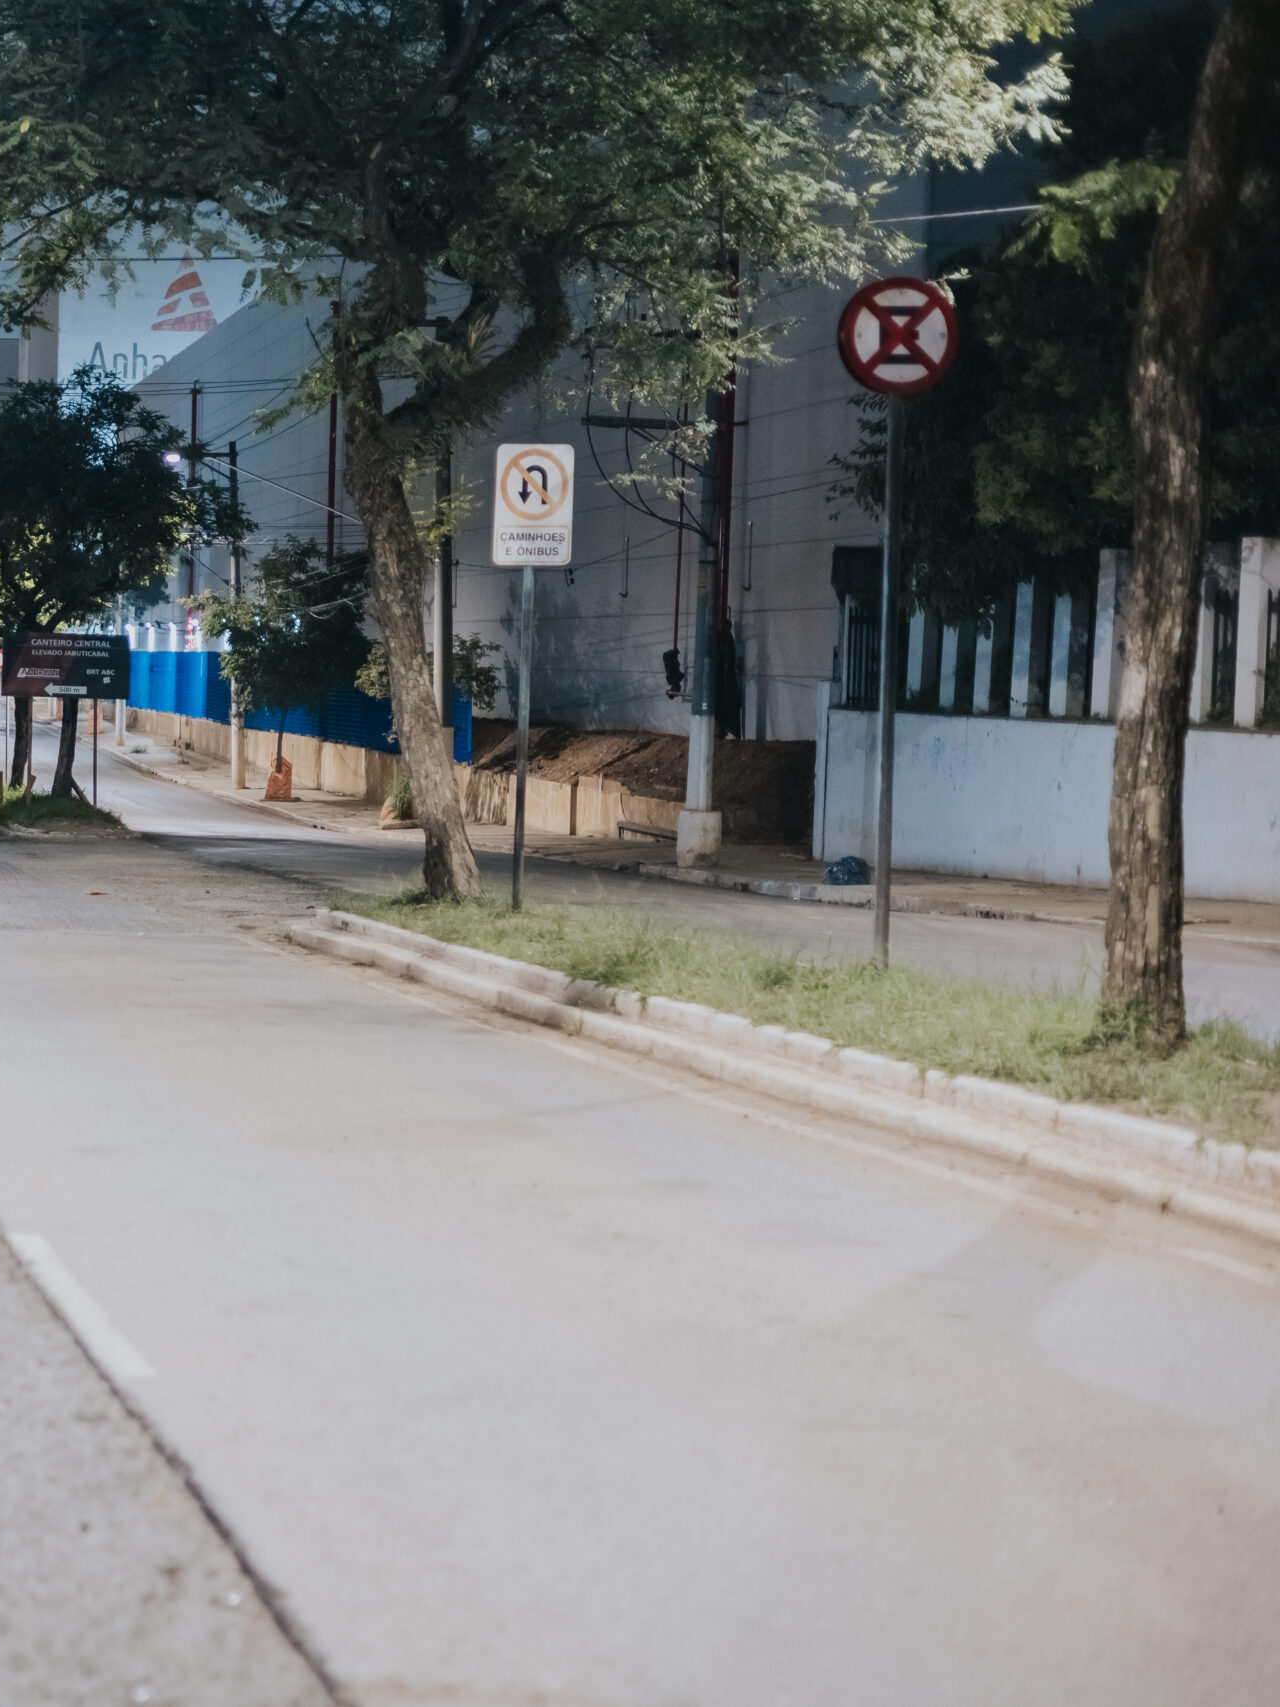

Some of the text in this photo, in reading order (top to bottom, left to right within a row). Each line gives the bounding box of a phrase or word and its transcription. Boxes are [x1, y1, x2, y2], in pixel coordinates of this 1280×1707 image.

[505, 547, 512, 556] E
[31, 638, 111, 648] CANTEIRO CENTRAL
